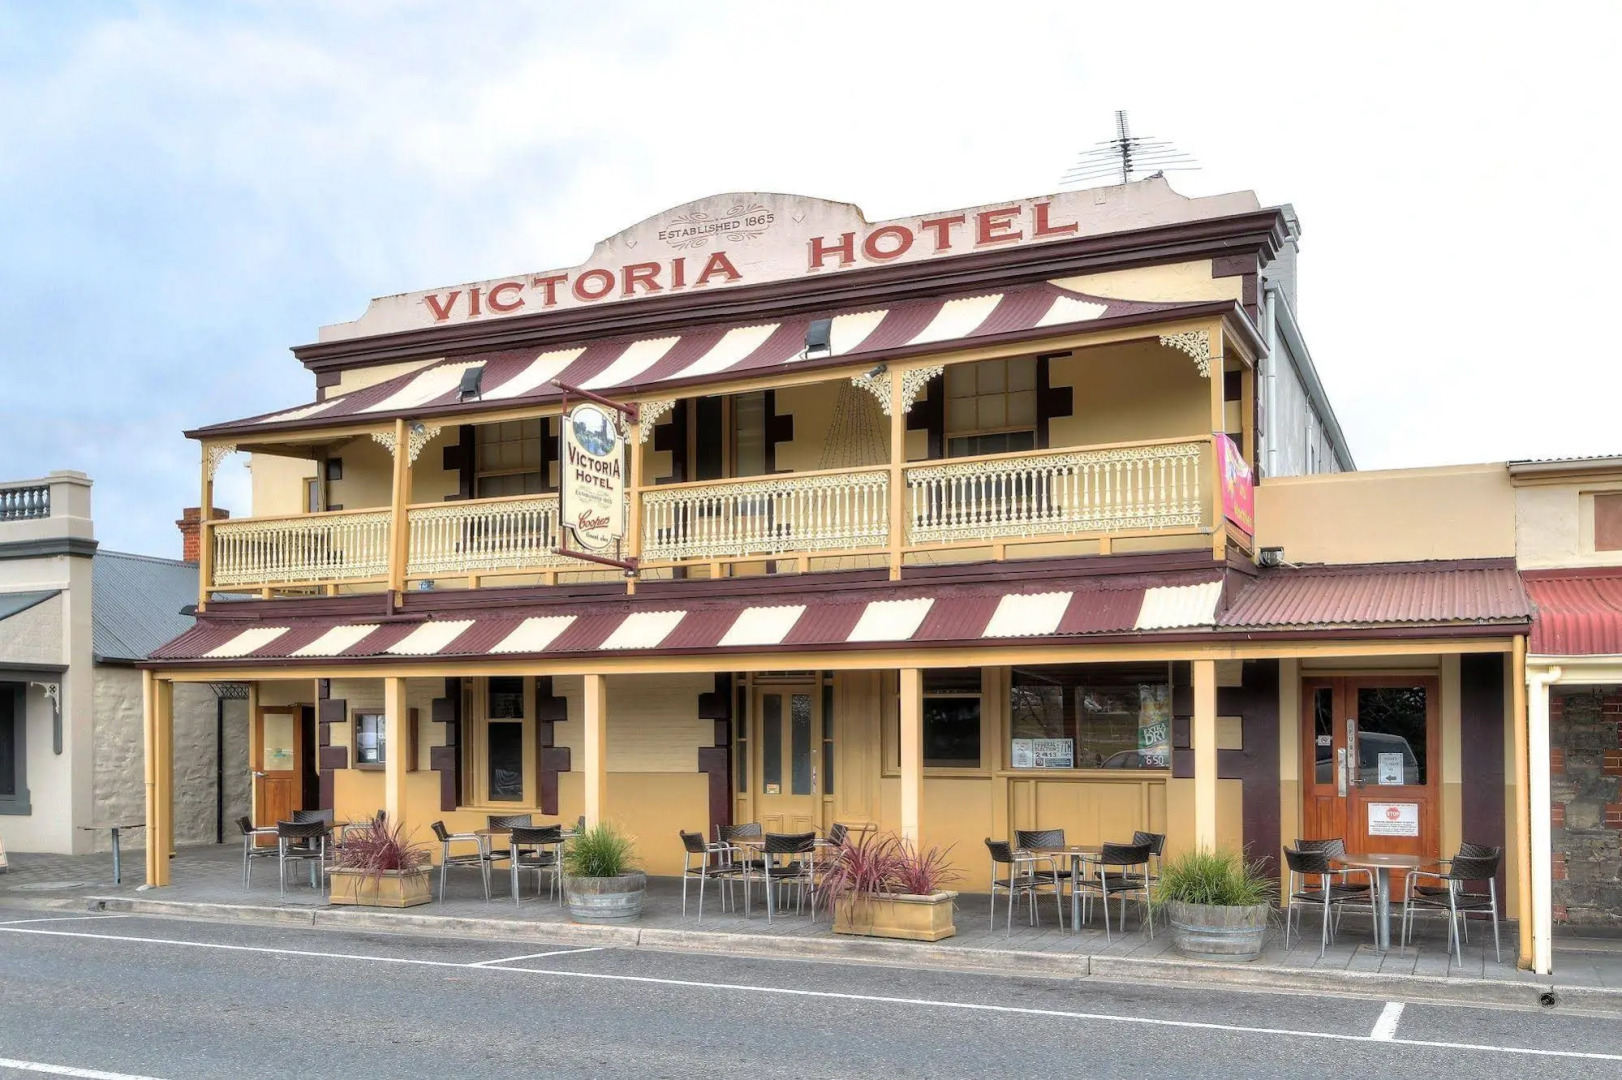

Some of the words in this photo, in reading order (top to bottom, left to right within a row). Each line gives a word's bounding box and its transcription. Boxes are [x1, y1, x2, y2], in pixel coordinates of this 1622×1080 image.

[658, 220, 741, 241] ESTABLISHED
[744, 213, 775, 228] 1865
[425, 251, 743, 325] VICTORIA
[806, 202, 1079, 273] HOTEL
[567, 442, 620, 479] VICTORIA
[575, 468, 614, 490] HOTEL
[578, 509, 610, 532] Coopers
[1143, 723, 1166, 735] EXTRA
[1144, 727, 1167, 746] DRY
